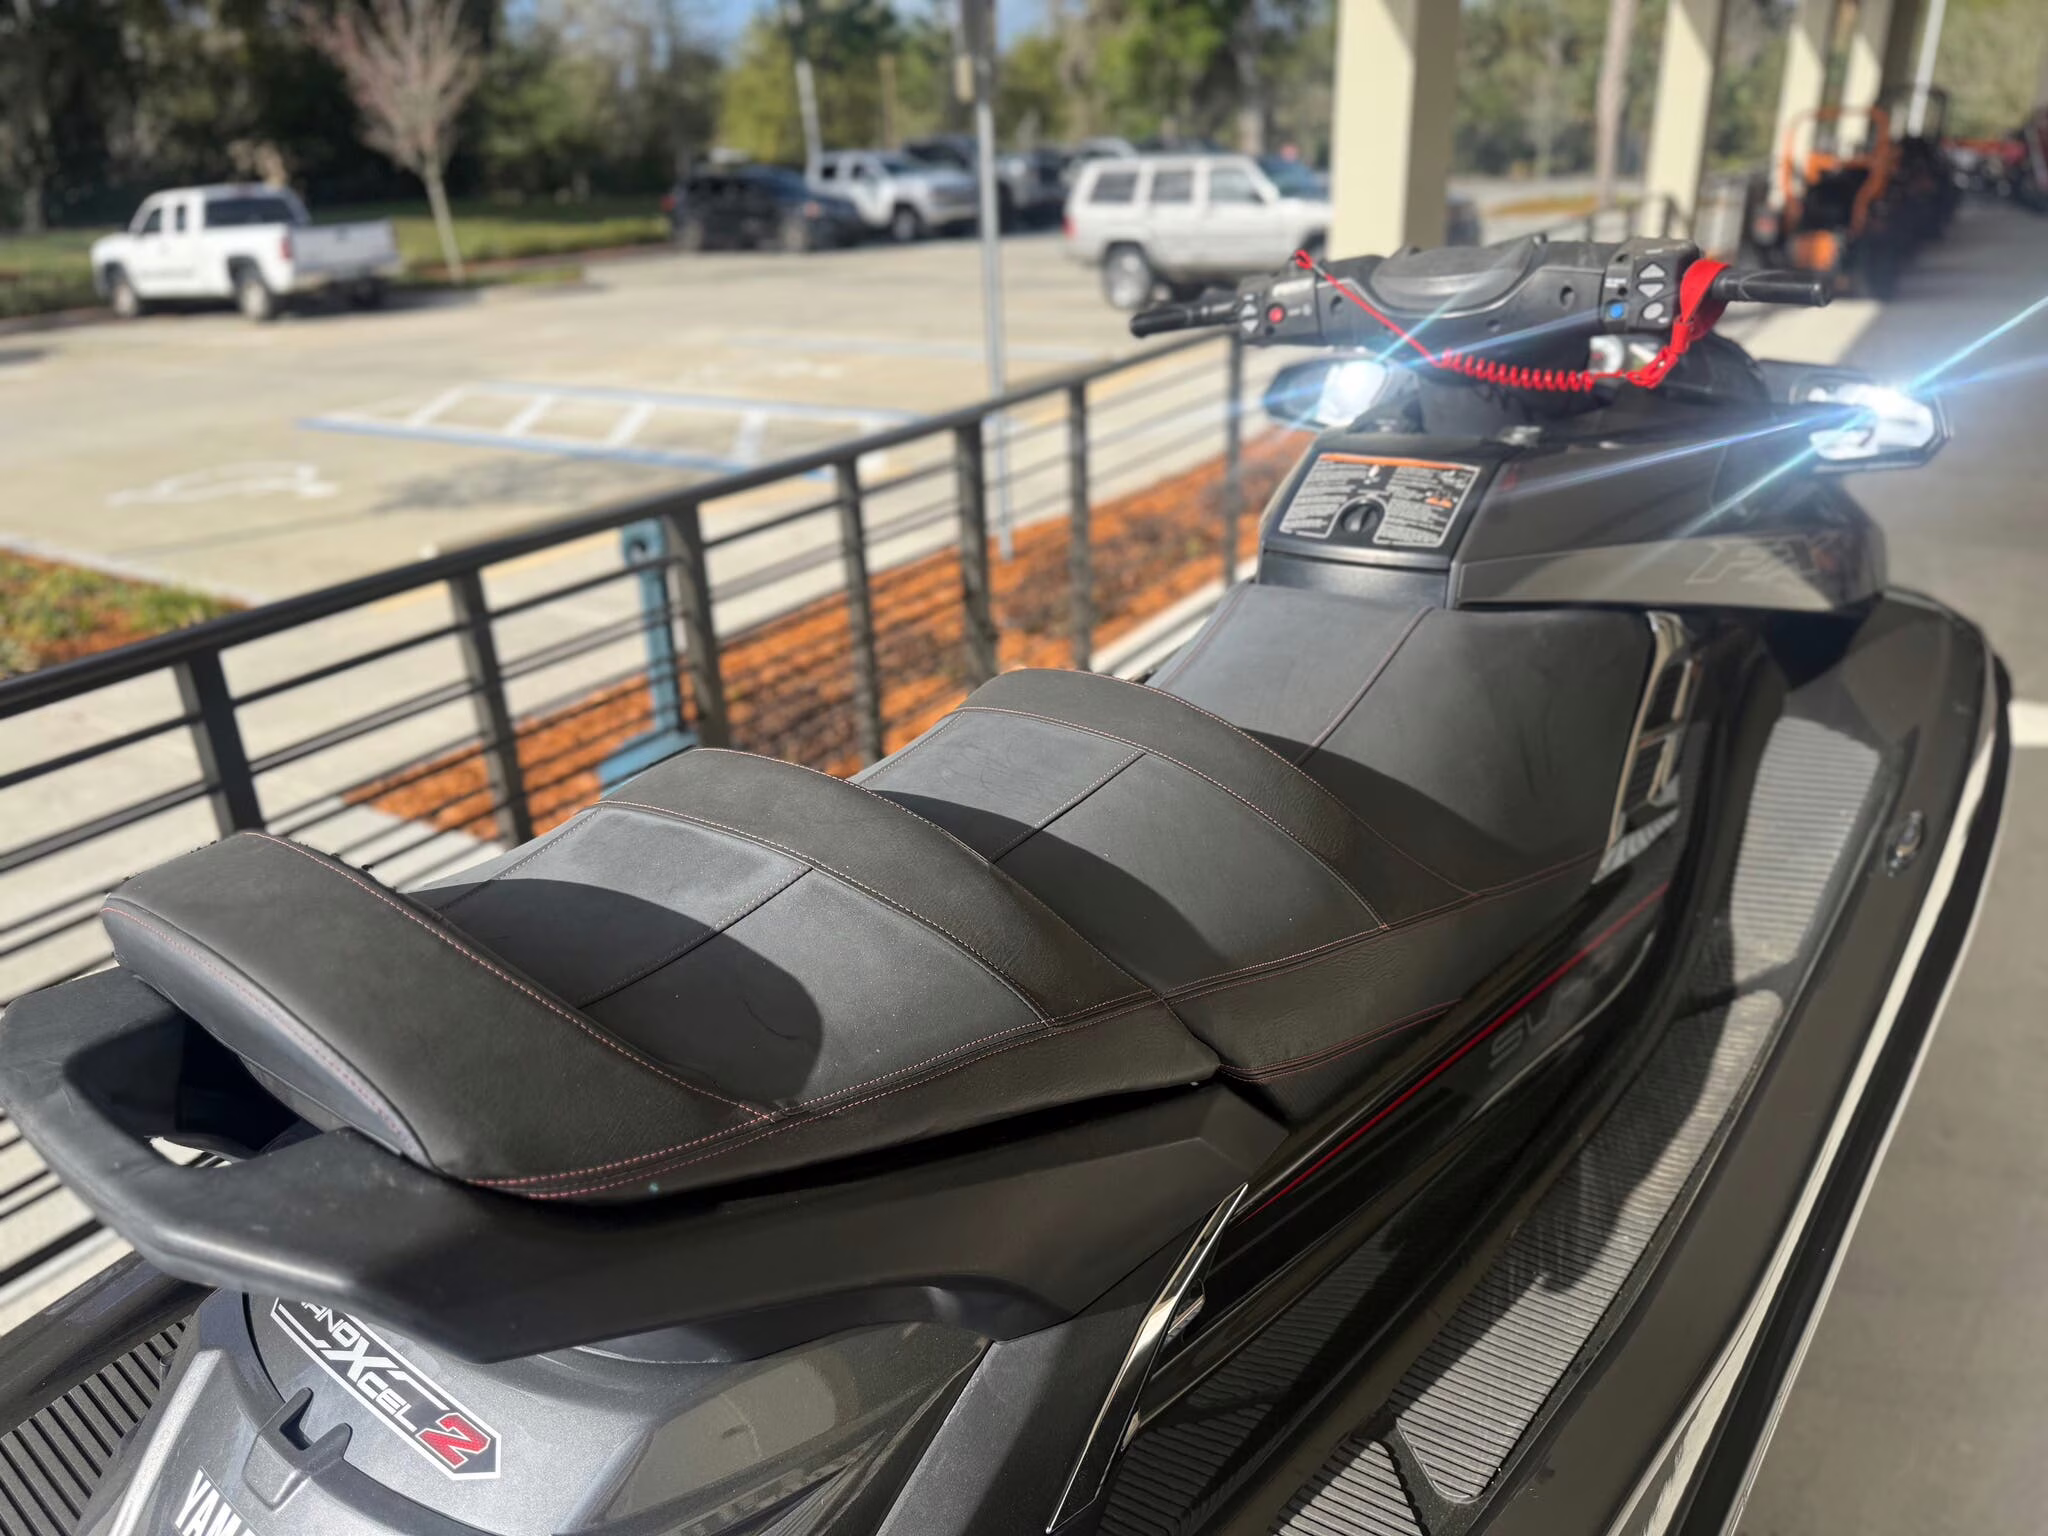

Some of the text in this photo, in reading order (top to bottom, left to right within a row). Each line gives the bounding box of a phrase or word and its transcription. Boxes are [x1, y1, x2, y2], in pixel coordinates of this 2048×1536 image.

[301, 1301, 491, 1469] ANOXCEL 2
[175, 1469, 257, 1536] YAM
